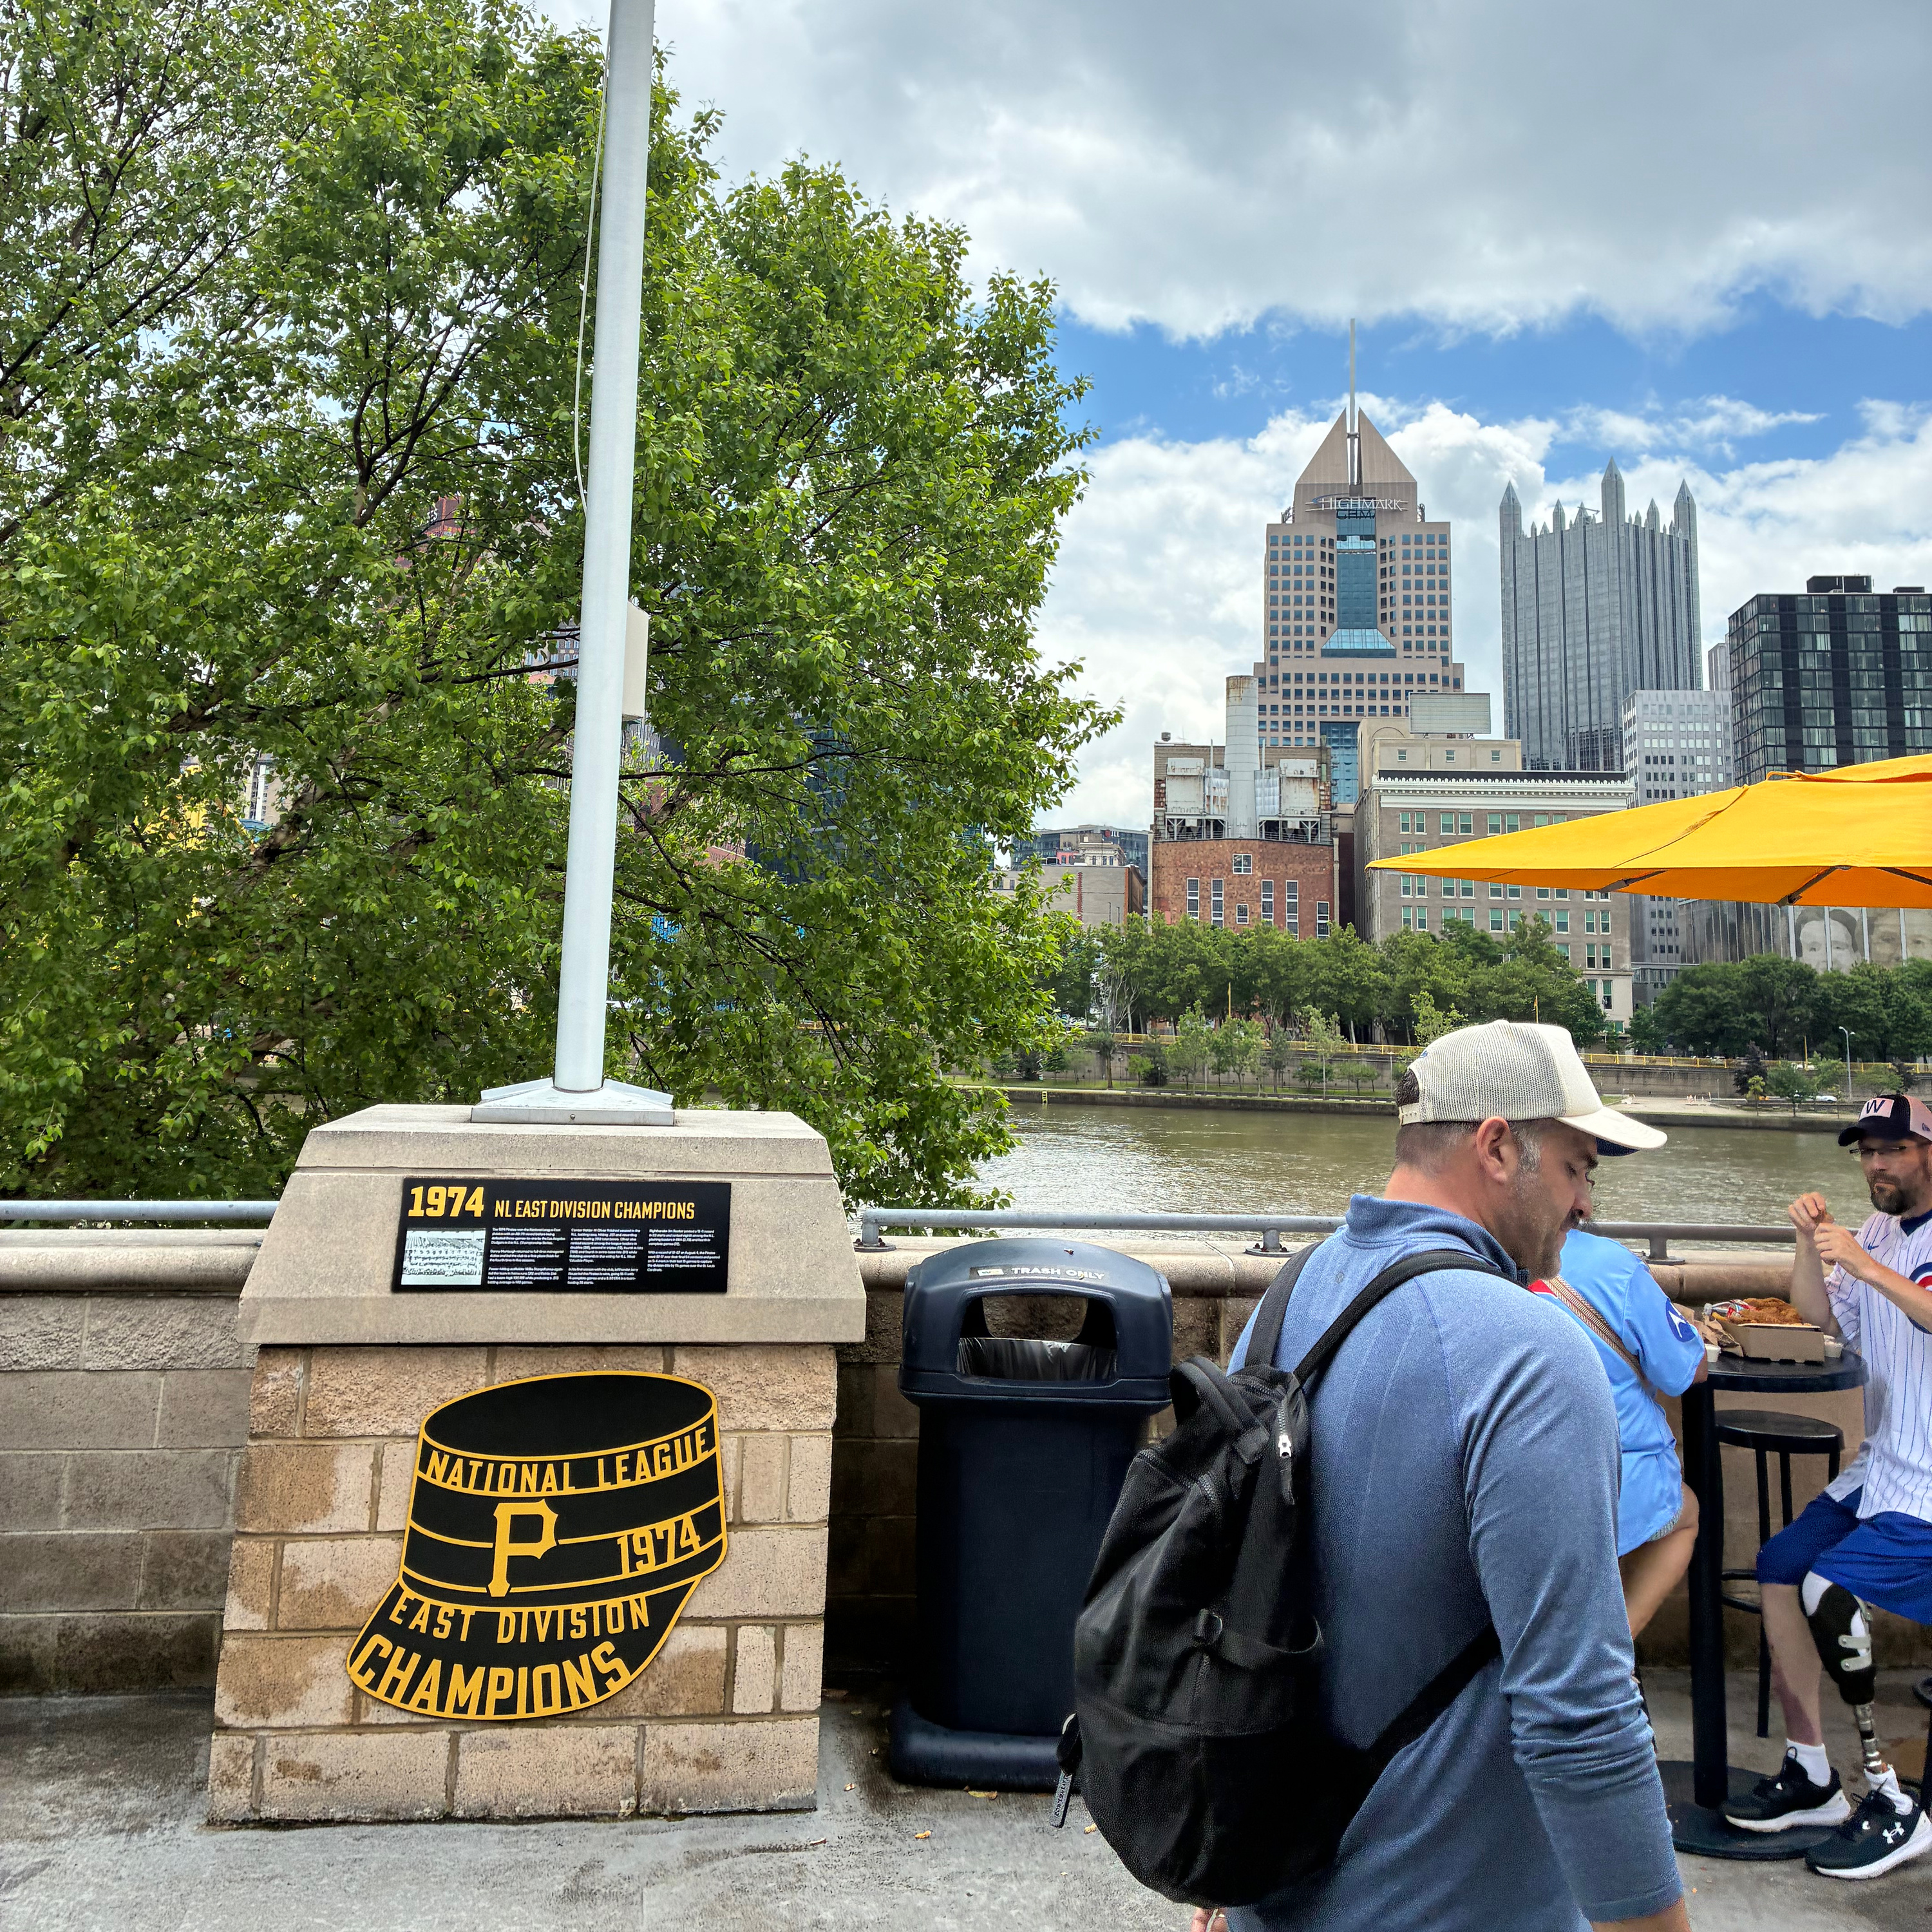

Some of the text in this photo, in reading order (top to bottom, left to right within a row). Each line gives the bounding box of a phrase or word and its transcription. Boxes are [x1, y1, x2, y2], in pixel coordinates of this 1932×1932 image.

[1322, 496, 1403, 511] HIGHMARK
[1866, 1099, 1886, 1114] W
[408, 1186, 695, 1220] 1974 NL EAST DIVISION CHAMPIONS
[1011, 1267, 1104, 1280] TRASH ONLY
[426, 1426, 708, 1493] NATIONAL LEAGUE
[487, 1498, 558, 1597] P
[617, 1514, 701, 1575] 1974
[388, 1588, 650, 1643] EAST DIVISION
[352, 1633, 632, 1716] CHAMPIONS
